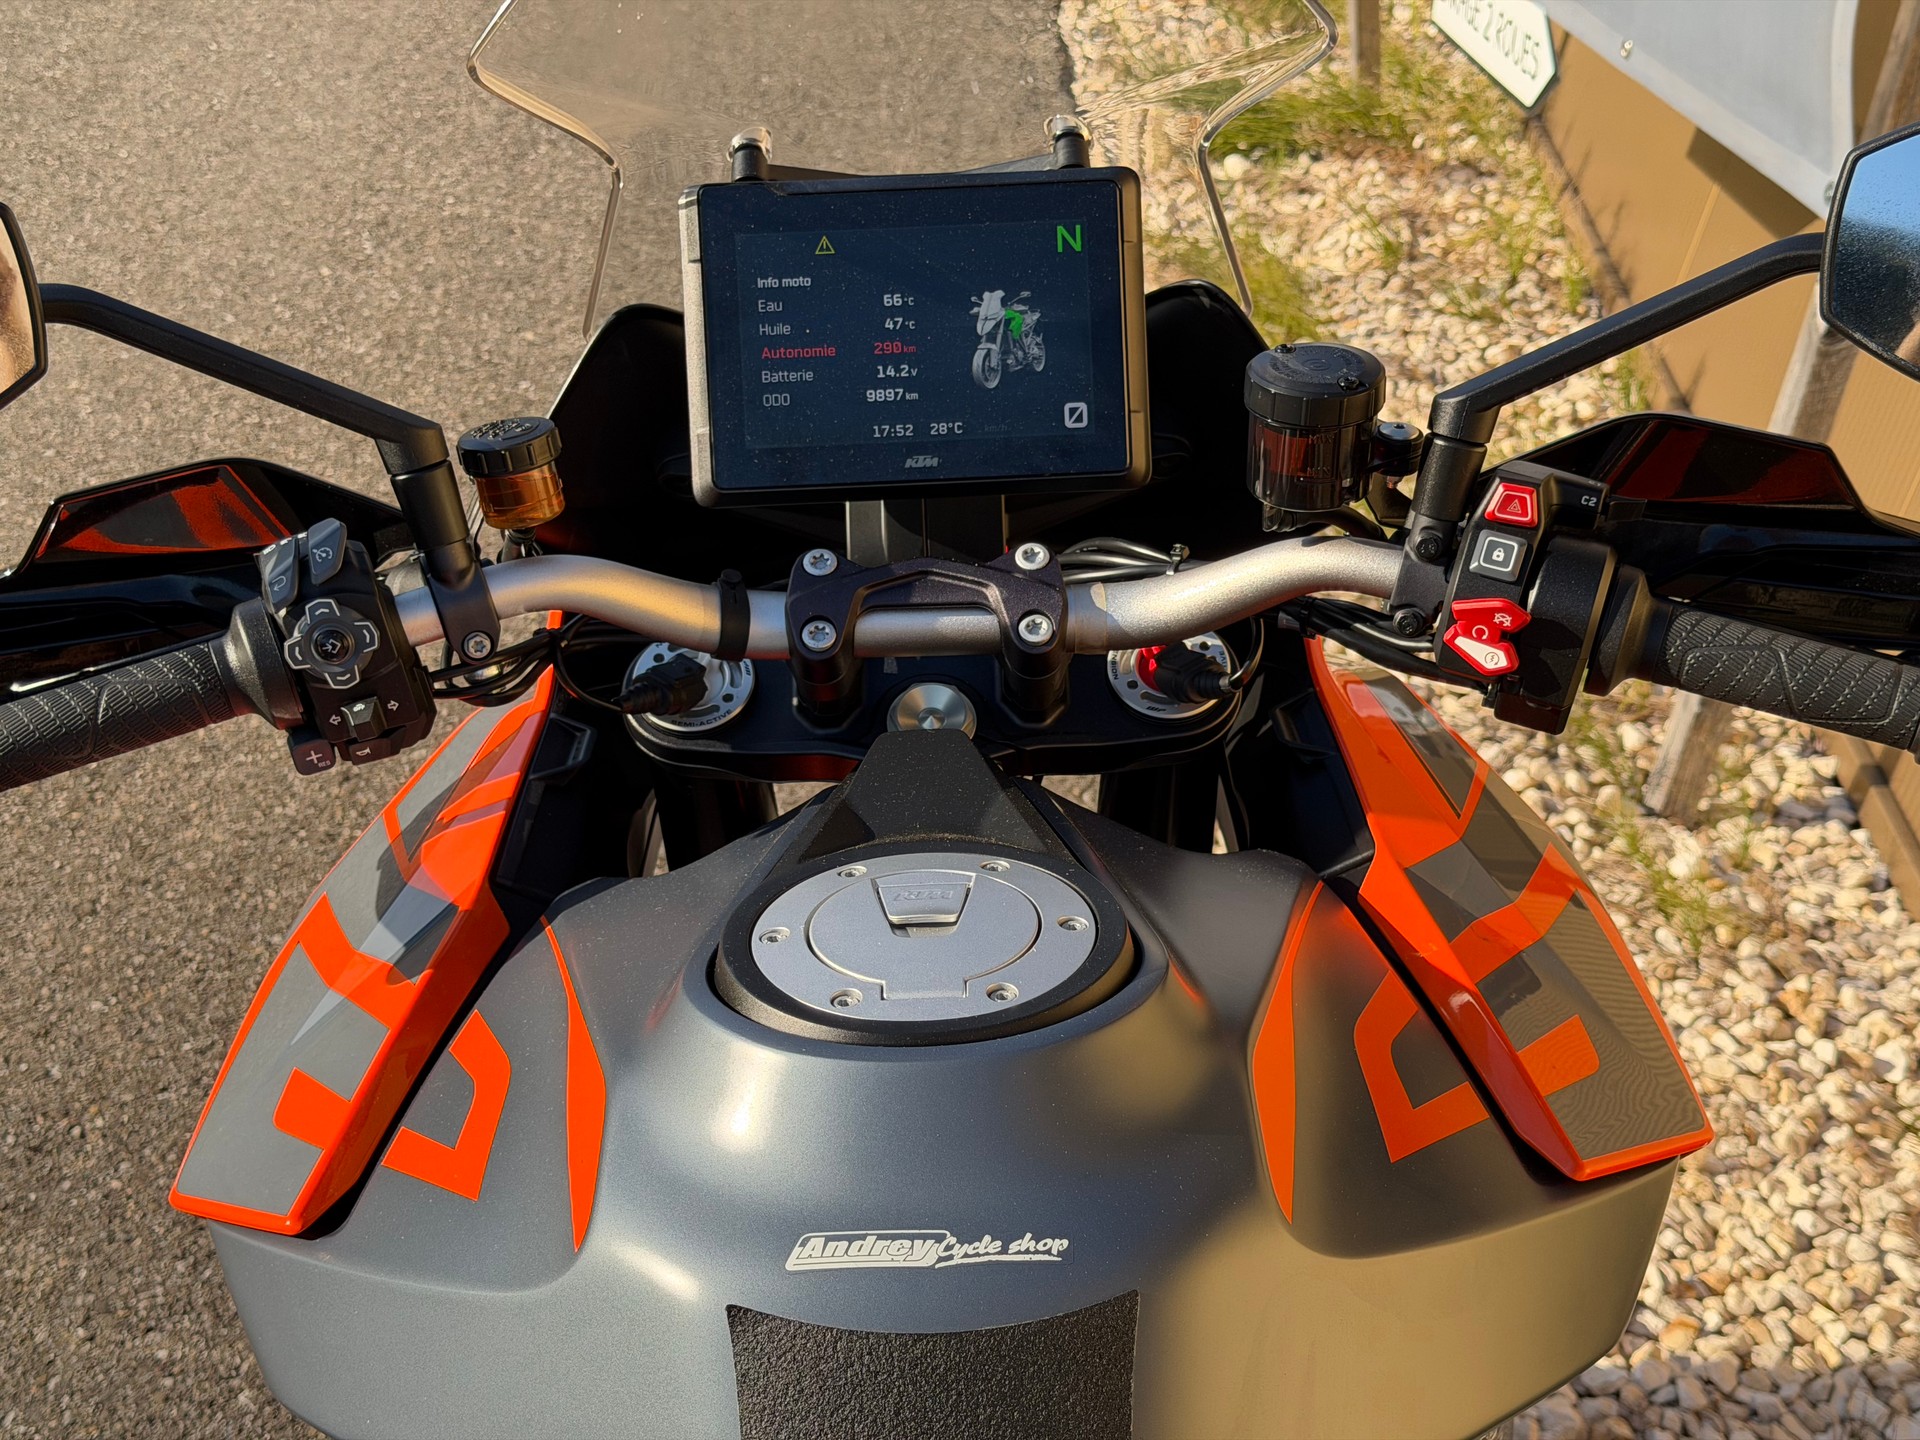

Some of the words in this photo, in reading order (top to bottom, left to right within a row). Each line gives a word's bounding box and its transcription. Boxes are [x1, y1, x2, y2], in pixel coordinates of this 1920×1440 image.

[1056, 224, 1082, 253] N
[757, 277, 779, 289] Info
[782, 276, 812, 288] moto
[758, 300, 783, 313] Eau
[759, 323, 791, 336] Huile
[761, 344, 836, 360] Autonomie
[761, 369, 814, 383] Batterie
[763, 393, 790, 407] ODO
[872, 423, 914, 438] 17:52
[930, 422, 963, 435] 28°C
[904, 455, 940, 468] KTM
[1580, 495, 1598, 507] C2
[799, 1234, 938, 1262] Andrey
[936, 1233, 1003, 1261] Cycle
[1007, 1232, 1070, 1256] shop
